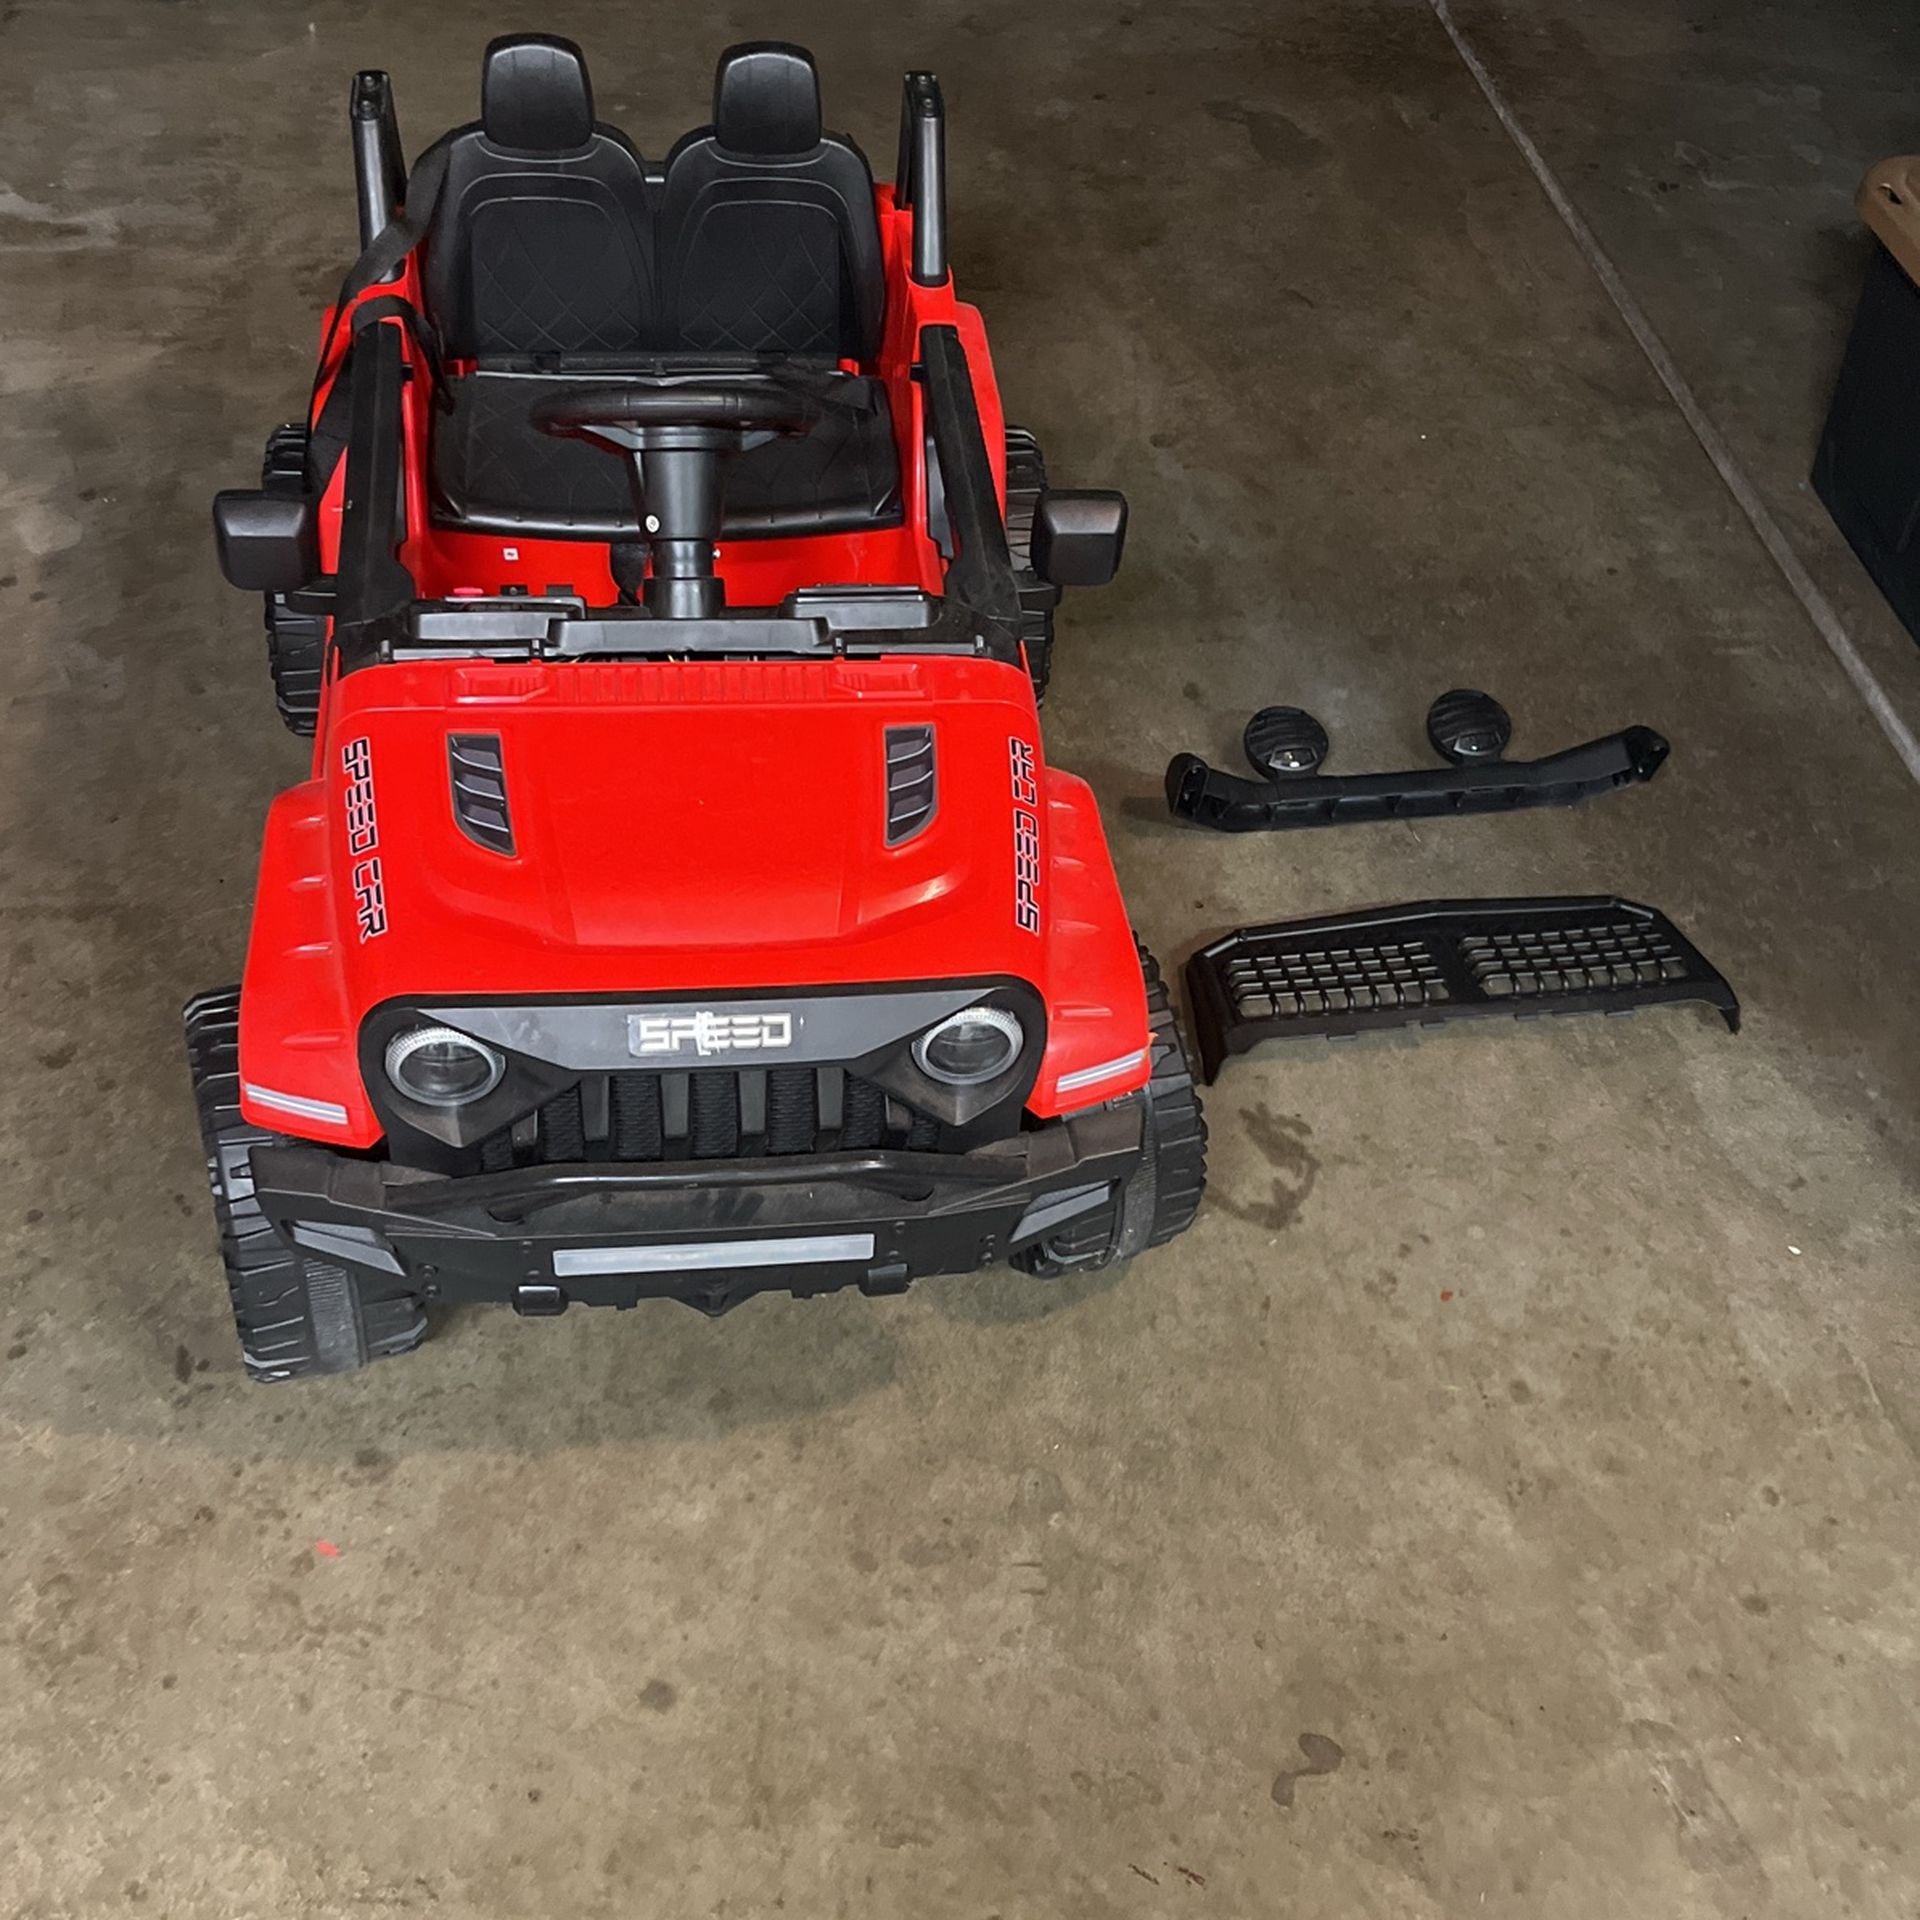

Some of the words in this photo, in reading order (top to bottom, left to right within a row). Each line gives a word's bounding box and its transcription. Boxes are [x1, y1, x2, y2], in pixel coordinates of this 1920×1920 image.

[342, 737, 378, 855] SPEED
[1008, 737, 1037, 807] CAR
[353, 857, 387, 943] CAR
[1013, 808, 1039, 936] SPEED
